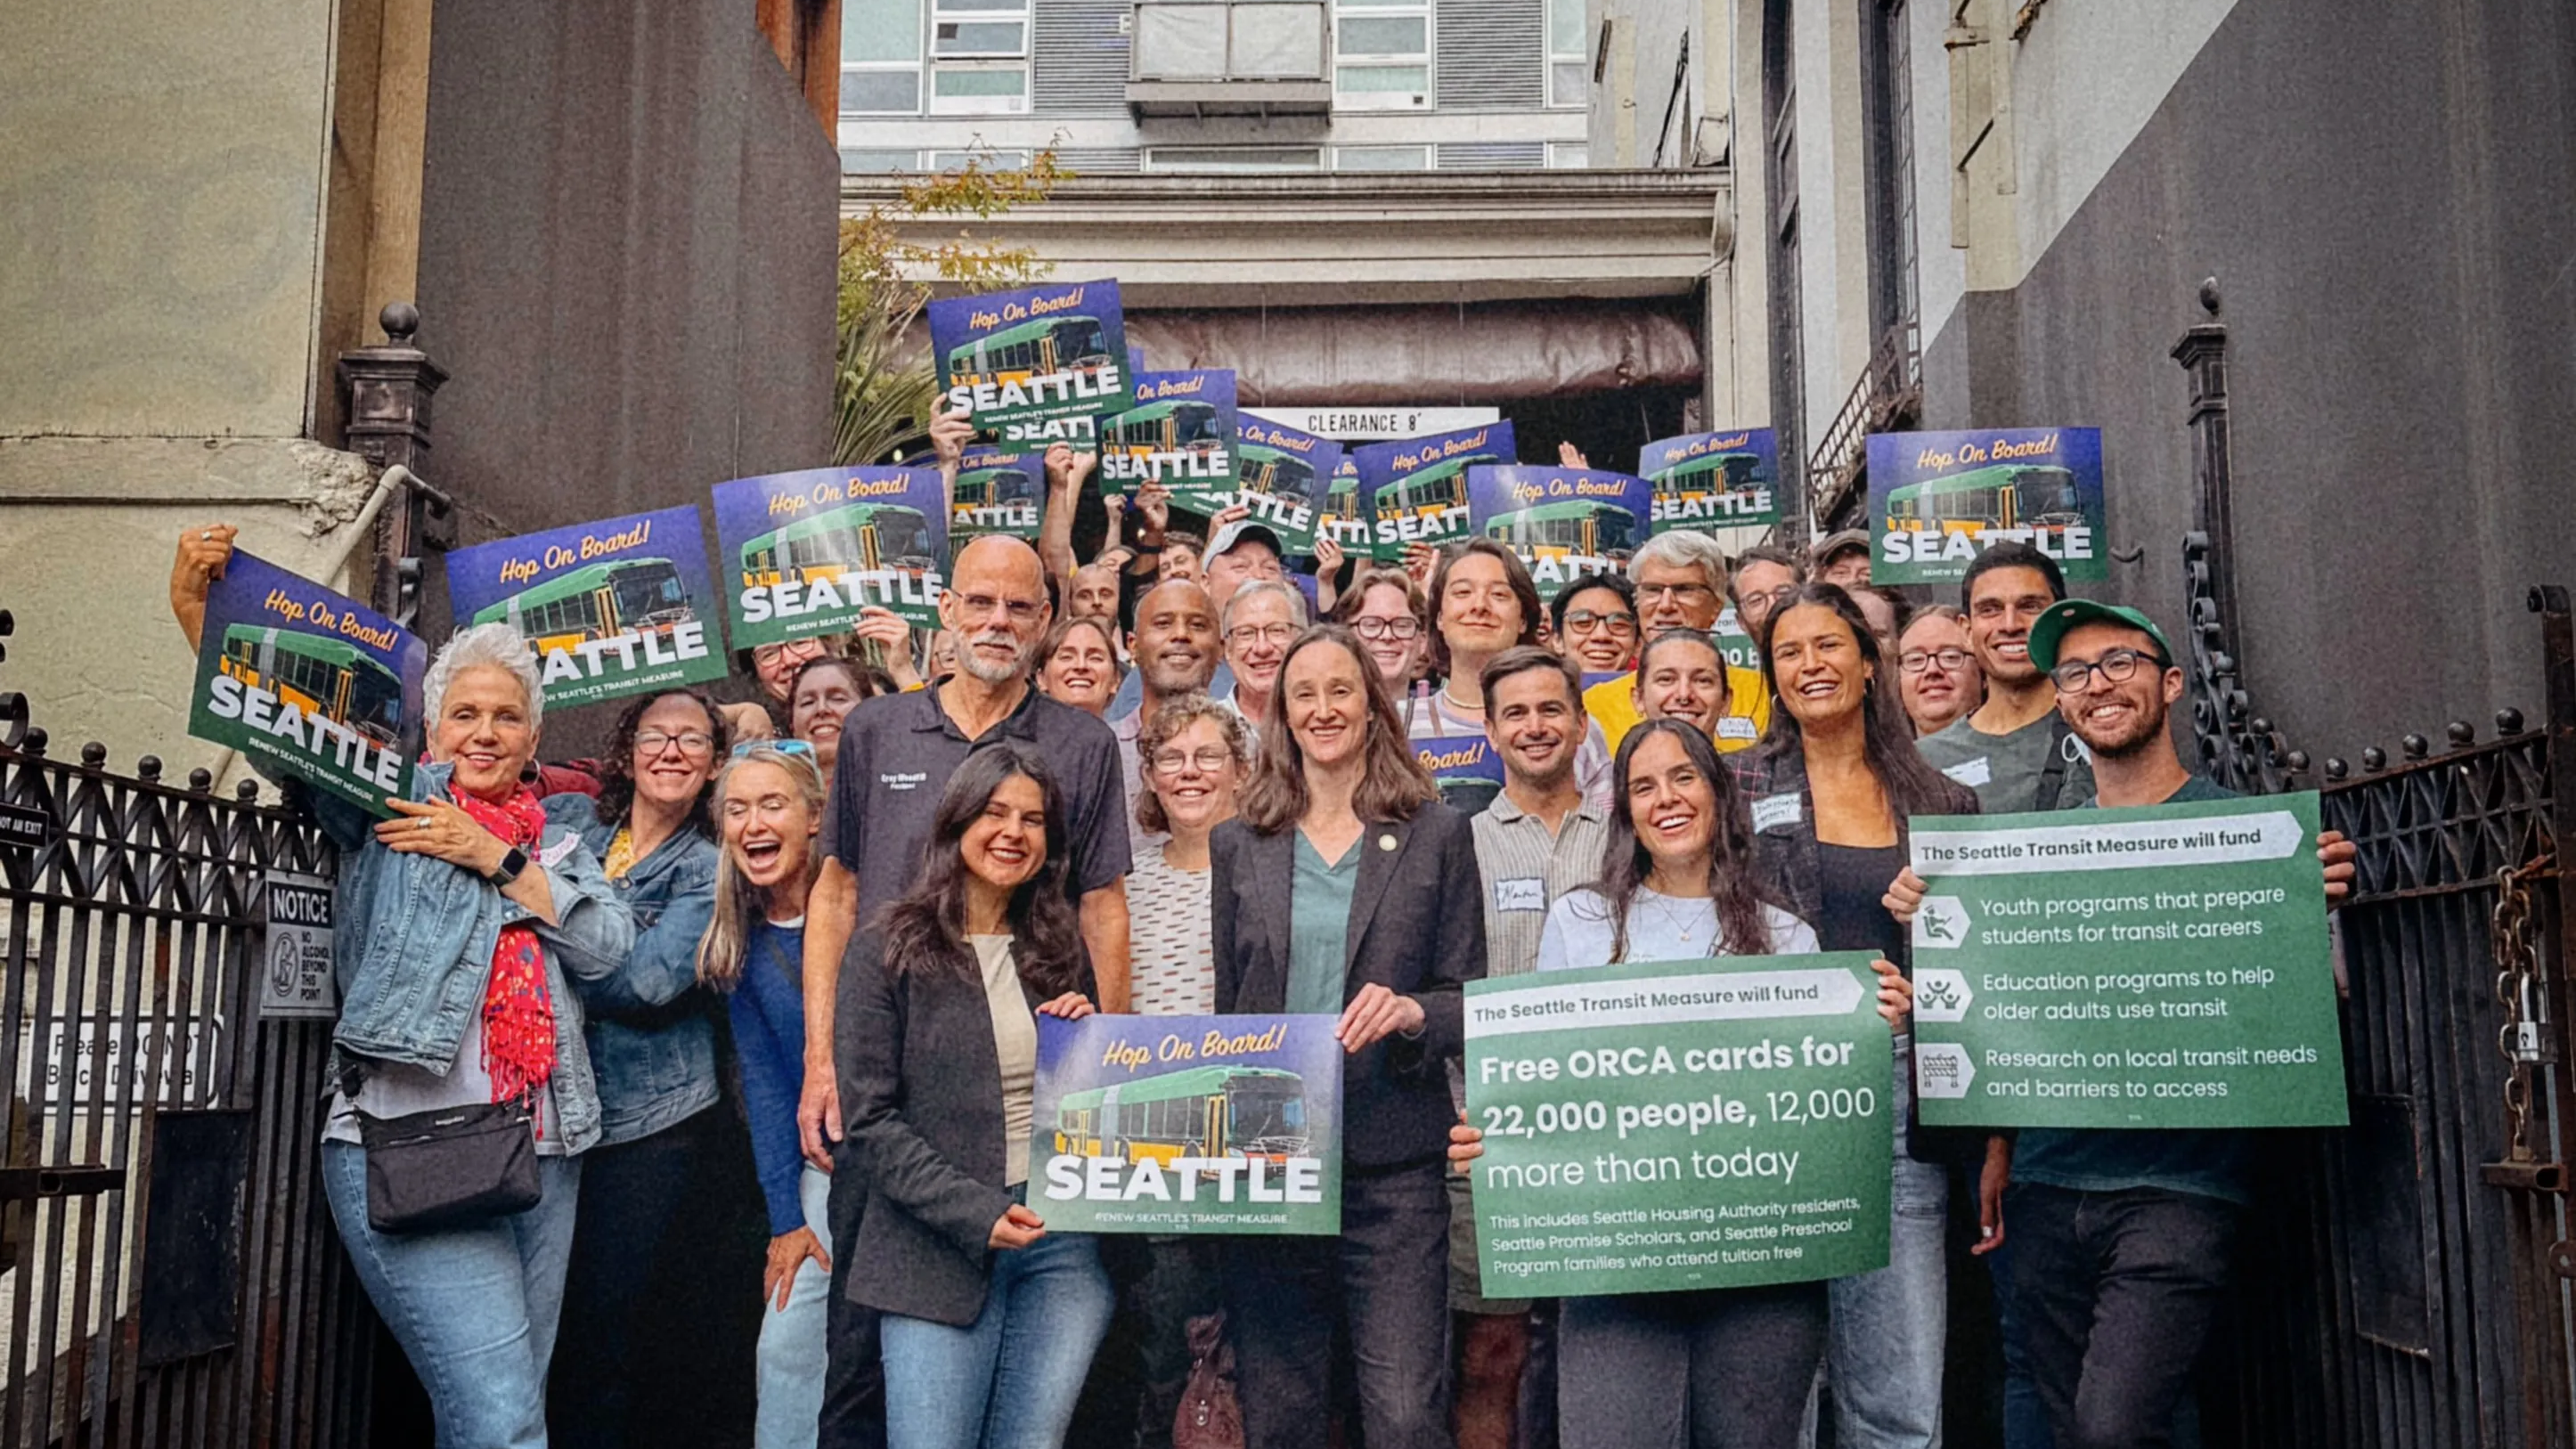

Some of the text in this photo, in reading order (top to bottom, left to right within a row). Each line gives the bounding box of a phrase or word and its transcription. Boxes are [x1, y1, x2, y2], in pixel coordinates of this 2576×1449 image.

[970, 285, 1084, 330] Hop On Board!
[948, 365, 1121, 414] SEATTLE
[1137, 376, 1204, 400] On Board!
[1006, 414, 1096, 441] SEATT
[1247, 426, 1266, 444] On
[1268, 431, 1316, 452] Board!
[1308, 414, 1398, 432] CLEARANCE
[1392, 429, 1488, 471] Hop On Board!
[1708, 432, 1749, 452] Board!
[1917, 433, 2058, 473] Hop On Board!
[1102, 451, 1230, 480] SEATTLE
[769, 473, 909, 517] Hop On Board!
[1513, 477, 1626, 501] Hop On Board!
[954, 507, 1039, 526] ATTLE
[1192, 489, 1312, 532] ATTLE
[1651, 491, 1773, 522] SEATTLE
[500, 519, 651, 583] Hop On Board!
[740, 570, 942, 623] SEATTLE
[265, 589, 398, 652] Hop On Board!
[540, 621, 708, 686] ATTLE
[208, 675, 402, 794] SEATTLE
[1419, 742, 1486, 770] Board!
[1921, 828, 2262, 861] The Seattle Transit Measure will fund
[273, 888, 328, 924] NOTICE
[1979, 887, 2286, 924] Youth programs that prepare
[1981, 917, 2262, 946] students for transit careers
[300, 989, 321, 1001] POINT
[1983, 966, 2274, 995] Education programs to help
[1475, 984, 1819, 1022] The Seattle Transit Measure will fund
[1983, 999, 2228, 1021] older adults use transit
[1103, 1023, 1287, 1072] Hop On Board!
[1480, 1035, 1855, 1085] Free ORCA cards for
[1985, 1044, 2318, 1069] Research on local transit needs
[1986, 1078, 2228, 1098] and barriers to access
[1482, 1087, 1875, 1139] 22,000 people, 12,000
[1044, 1155, 1322, 1202] SEATTLE
[1488, 1145, 1799, 1189] more than today
[1095, 1212, 1287, 1224] RENEW SEATTLE'S TRANSIT MEASURE
[1490, 1197, 1861, 1229] This includes Seattle Housing Authority residents,
[1491, 1217, 1852, 1253] Seattle Promise Scholars, and Seattle Preschool
[1493, 1245, 1803, 1277] Program families who attend tuition free
